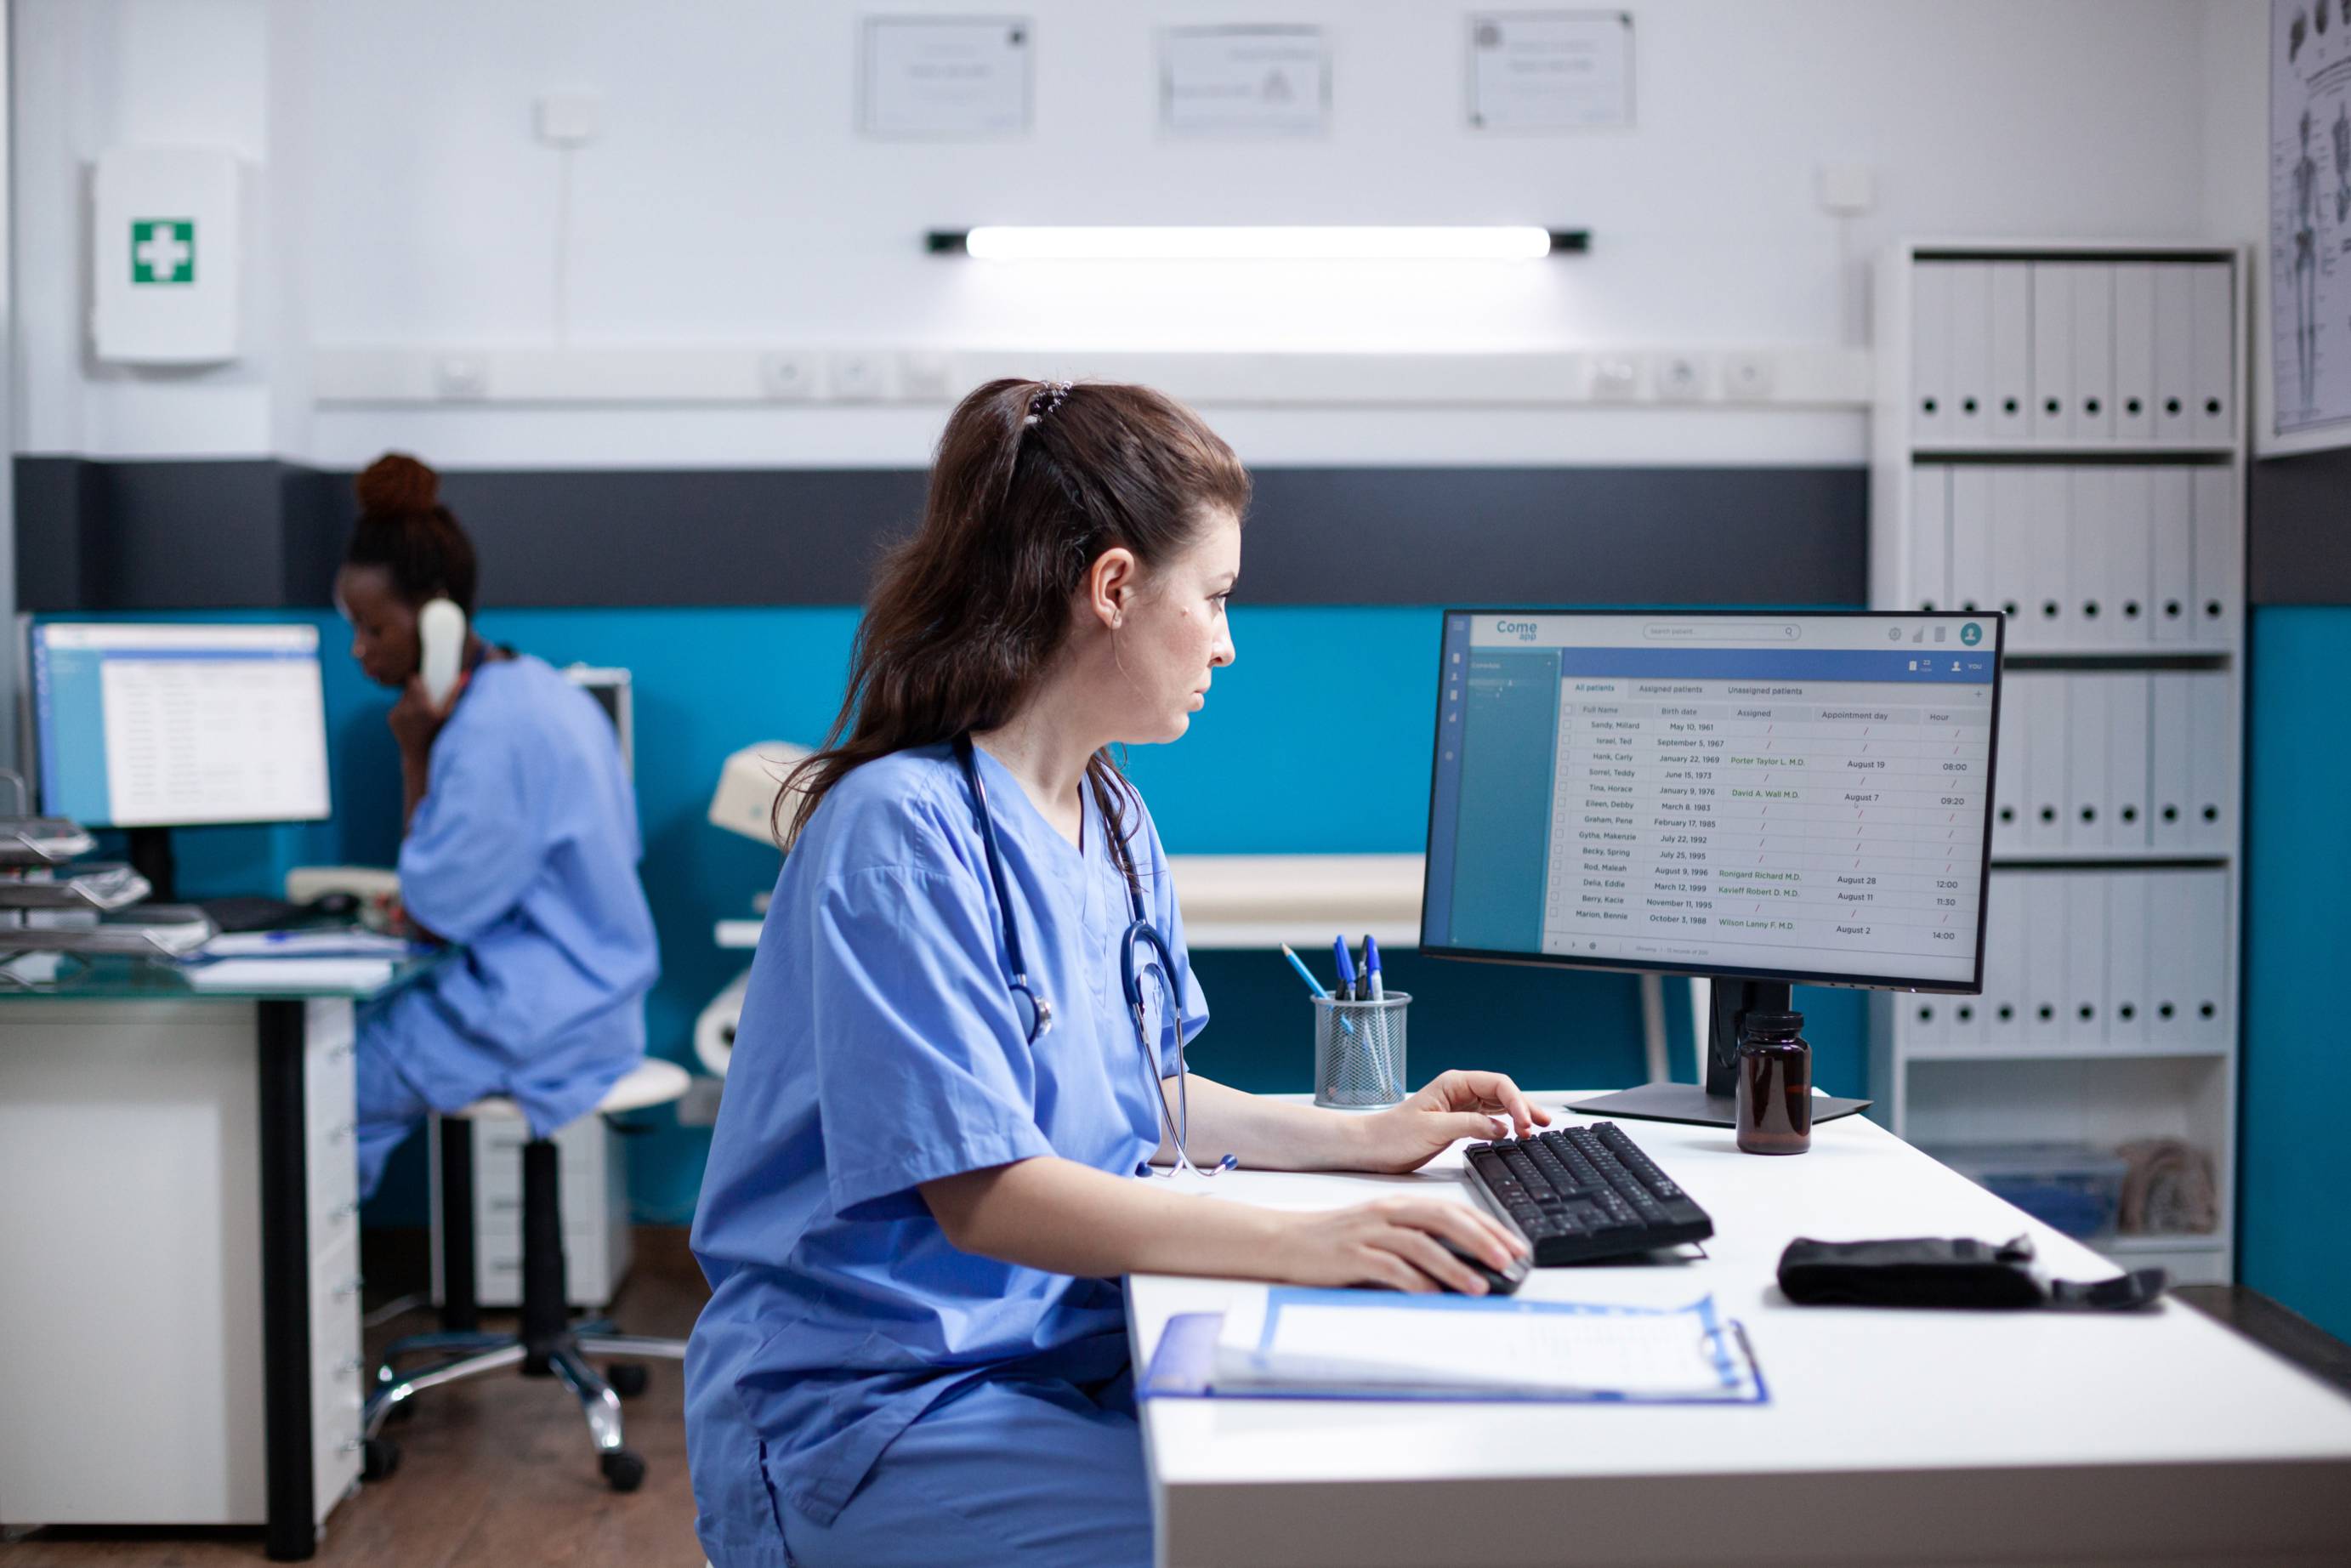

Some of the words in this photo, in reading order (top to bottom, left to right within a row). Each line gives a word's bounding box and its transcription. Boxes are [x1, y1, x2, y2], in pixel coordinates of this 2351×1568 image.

[1496, 620, 1538, 632] Come
[1519, 632, 1537, 641] app
[1639, 685, 1672, 694] Assigned
[1673, 686, 1703, 694] patients
[1728, 687, 1771, 696] Unassigned
[1772, 687, 1803, 695] patients
[1737, 709, 1771, 718] Assigned
[1821, 711, 1872, 719] Appointment
[1874, 712, 1888, 721] day
[1670, 723, 1685, 732] May
[1619, 737, 1632, 745] Ted
[1657, 739, 1697, 747] September
[1659, 755, 1688, 764] January
[1731, 757, 1754, 765] Porter
[1756, 757, 1779, 766] Taylor
[1847, 760, 1874, 769] August
[1942, 763, 1968, 771] 08:00
[1614, 769, 1635, 778] Teddy
[1607, 785, 1633, 793] Horace
[1659, 787, 1688, 796] January
[1844, 793, 1872, 802] August
[1941, 797, 1965, 806] 09:20
[1610, 801, 1634, 810] Debby
[1654, 818, 1687, 828] February
[1660, 835, 1676, 844] July
[1607, 848, 1630, 858] Spring
[1659, 851, 1674, 859] July
[1655, 867, 1680, 875] August
[1755, 871, 1783, 880] Richard
[1604, 880, 1625, 888] Eddie
[1837, 876, 1864, 885] August
[1936, 880, 1958, 889] 12:00
[1689, 884, 1707, 892] 1999
[1746, 887, 1772, 896] Robert
[1837, 892, 1865, 902] August
[1646, 898, 1684, 907] November
[1696, 901, 1712, 909] 1995
[1937, 898, 1956, 906] 11:30
[1603, 911, 1628, 920] Bennie
[1649, 914, 1680, 923] October
[1690, 917, 1706, 925] 1988
[1719, 918, 1744, 927] Wilson
[1836, 925, 1863, 935] August
[1933, 932, 1955, 940] 14:00
